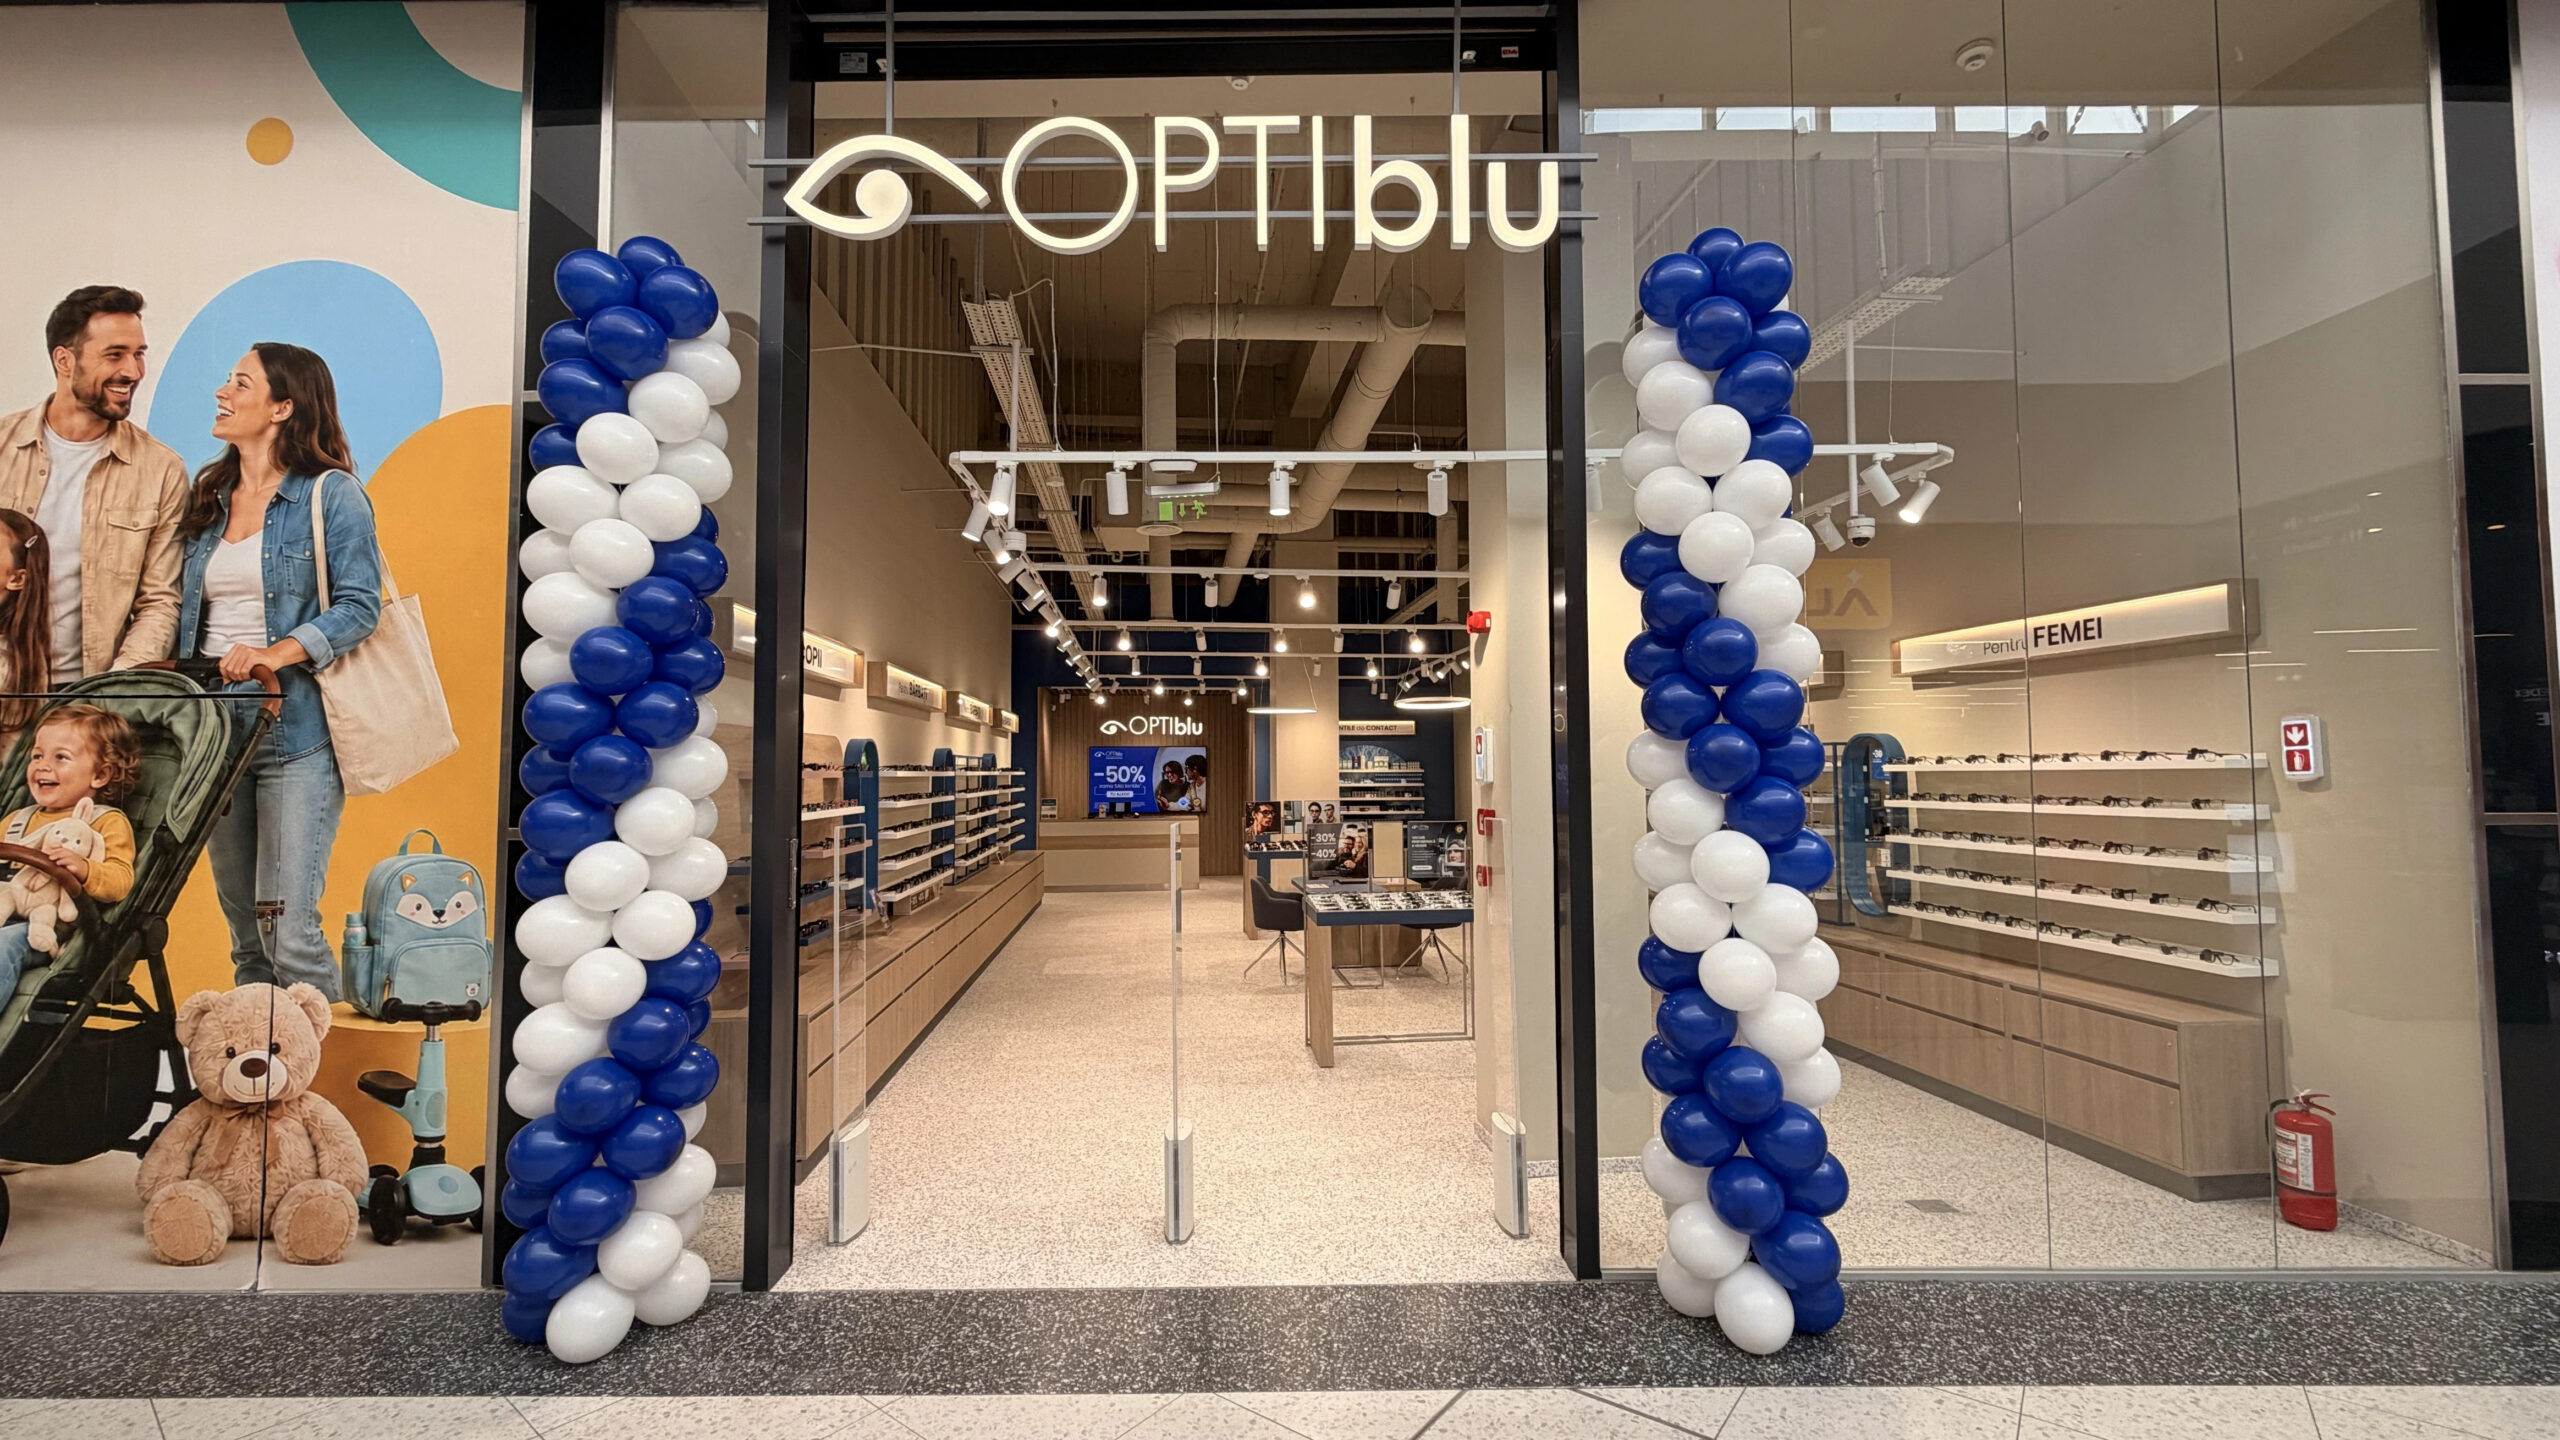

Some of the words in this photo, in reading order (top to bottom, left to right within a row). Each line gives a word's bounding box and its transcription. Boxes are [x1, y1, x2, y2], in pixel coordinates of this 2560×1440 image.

[1001, 113, 1560, 256] OPTIblu
[2033, 617, 2103, 648] FEMEI
[803, 644, 823, 668] OPII
[1129, 716, 1203, 736] OPTIblu
[1094, 766, 1146, 783] -50%
[1311, 833, 1336, 842] -30%
[1311, 849, 1336, 858] -40%
